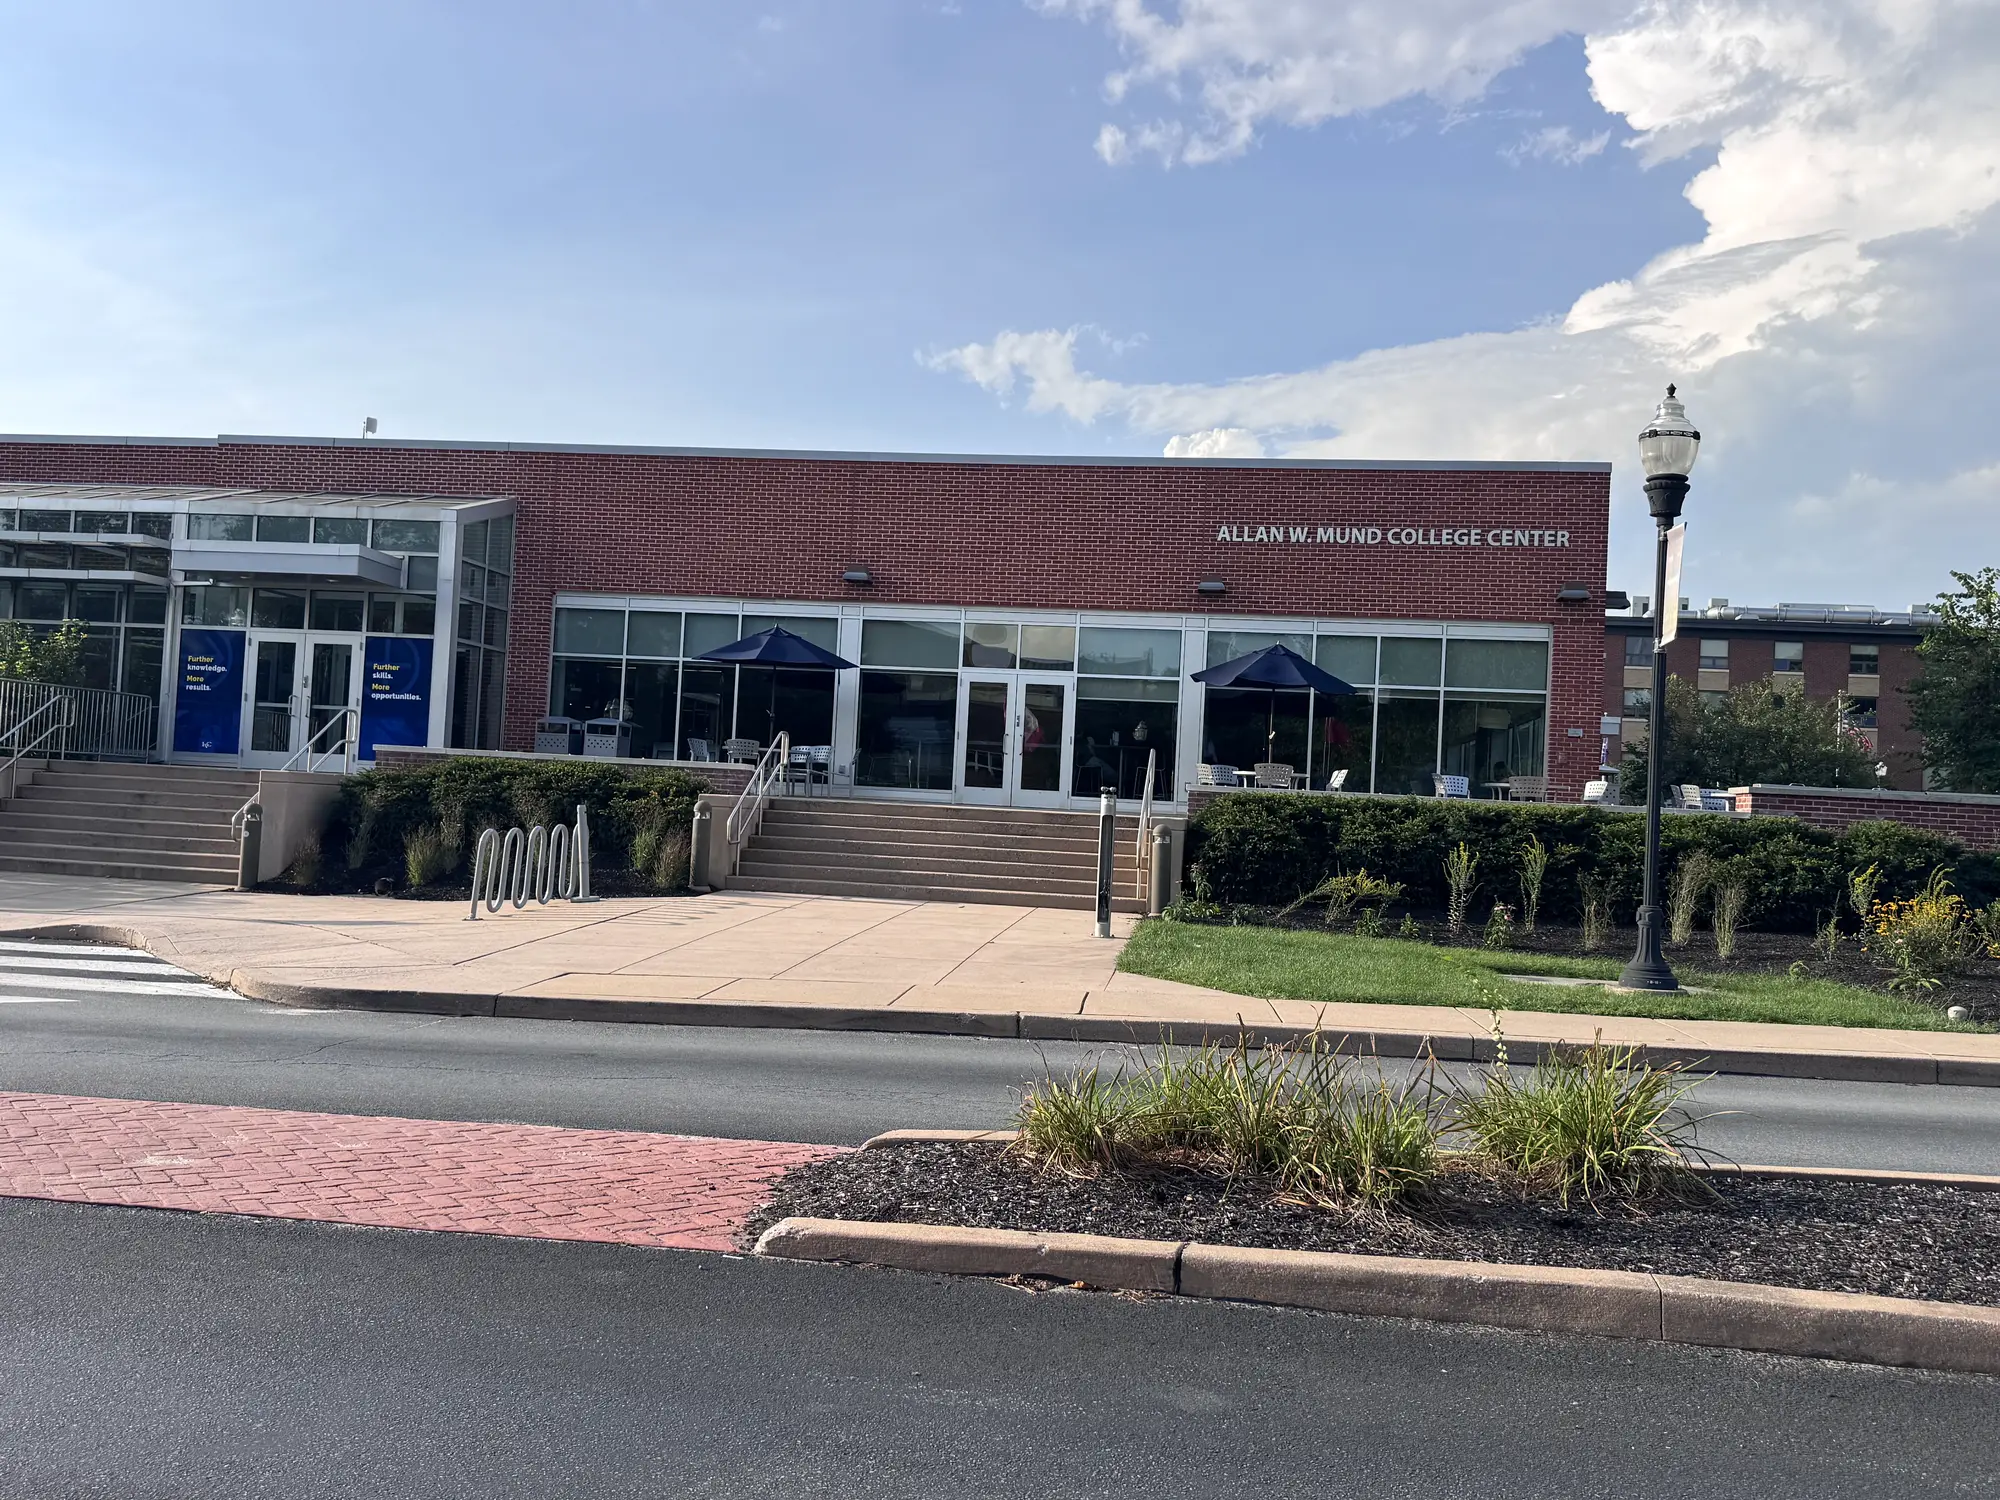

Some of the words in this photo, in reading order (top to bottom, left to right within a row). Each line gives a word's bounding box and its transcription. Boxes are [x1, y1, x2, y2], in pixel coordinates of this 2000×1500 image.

[1217, 525, 1284, 543] ALLAN
[1289, 527, 1312, 543] W.
[1316, 527, 1382, 544] MUND
[1387, 528, 1482, 546] COLLEGE
[1487, 529, 1570, 547] CENTER
[187, 655, 214, 663] Further
[187, 663, 228, 673] knowledge.
[373, 663, 400, 671] Further
[372, 671, 393, 679] skills.
[185, 683, 212, 691] results.
[371, 683, 390, 691] More
[371, 692, 422, 701] opportunities.
